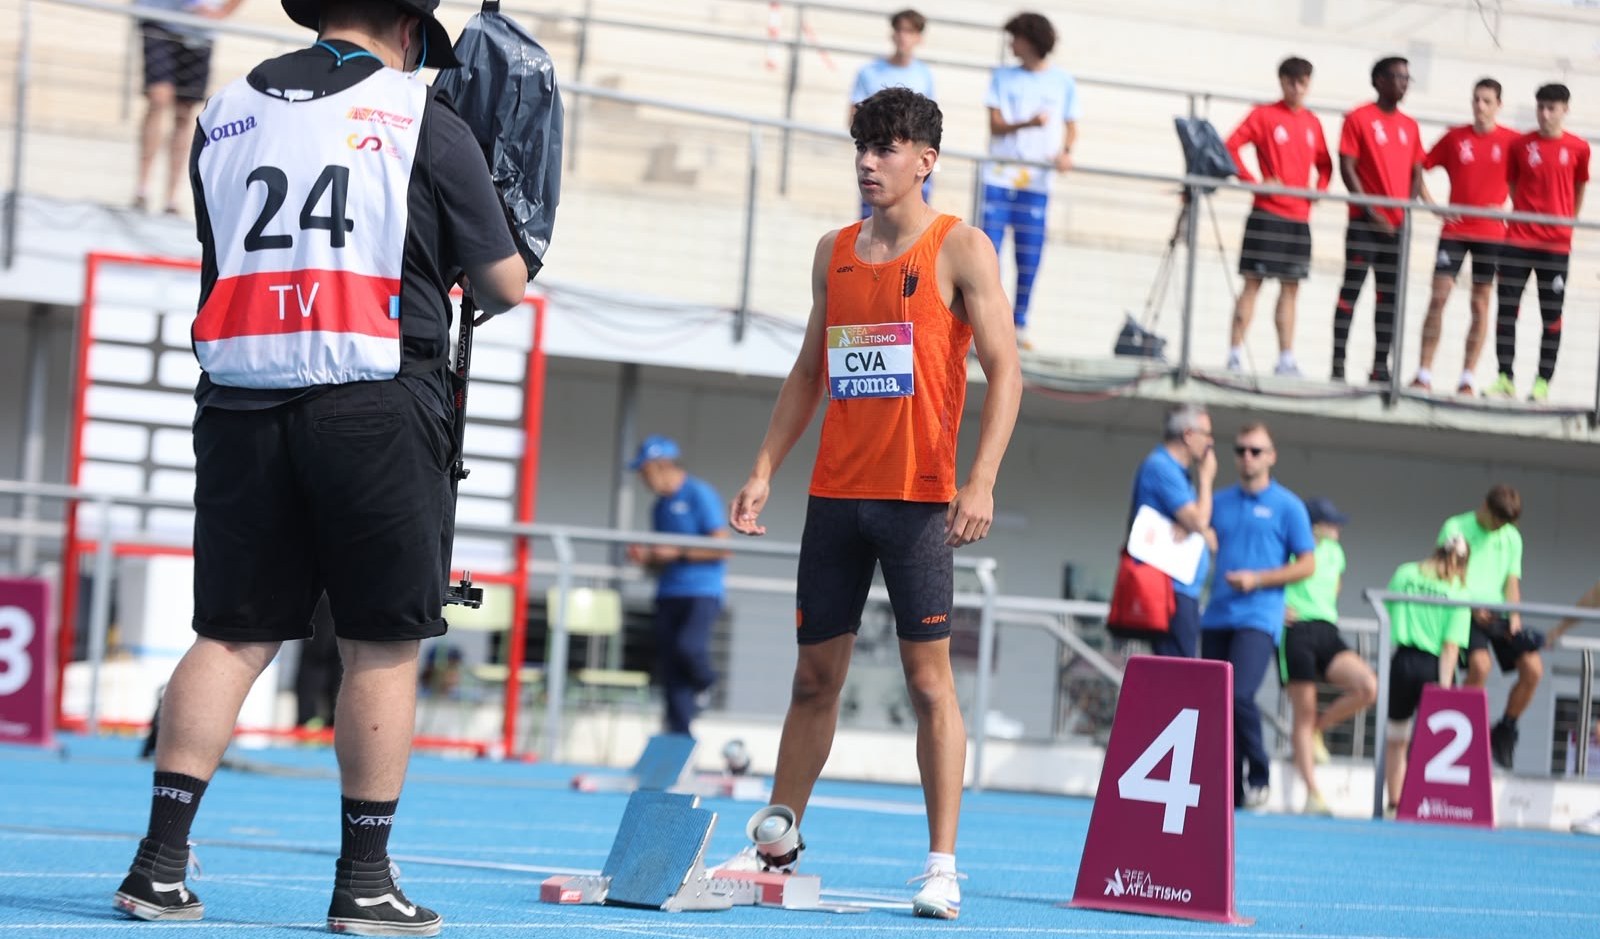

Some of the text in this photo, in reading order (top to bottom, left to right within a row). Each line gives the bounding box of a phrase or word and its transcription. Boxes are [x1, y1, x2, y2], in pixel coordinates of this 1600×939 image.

[243, 164, 355, 252] 24
[269, 281, 320, 320] TV
[851, 334, 897, 344] ATLETISMO
[845, 351, 887, 373] CVA
[0, 605, 36, 696] 3
[1424, 709, 1473, 786] 2
[1118, 707, 1201, 835] 4
[152, 786, 194, 804] ANS
[1122, 868, 1152, 885] RFEA
[1125, 882, 1192, 903] ATLETISMO
